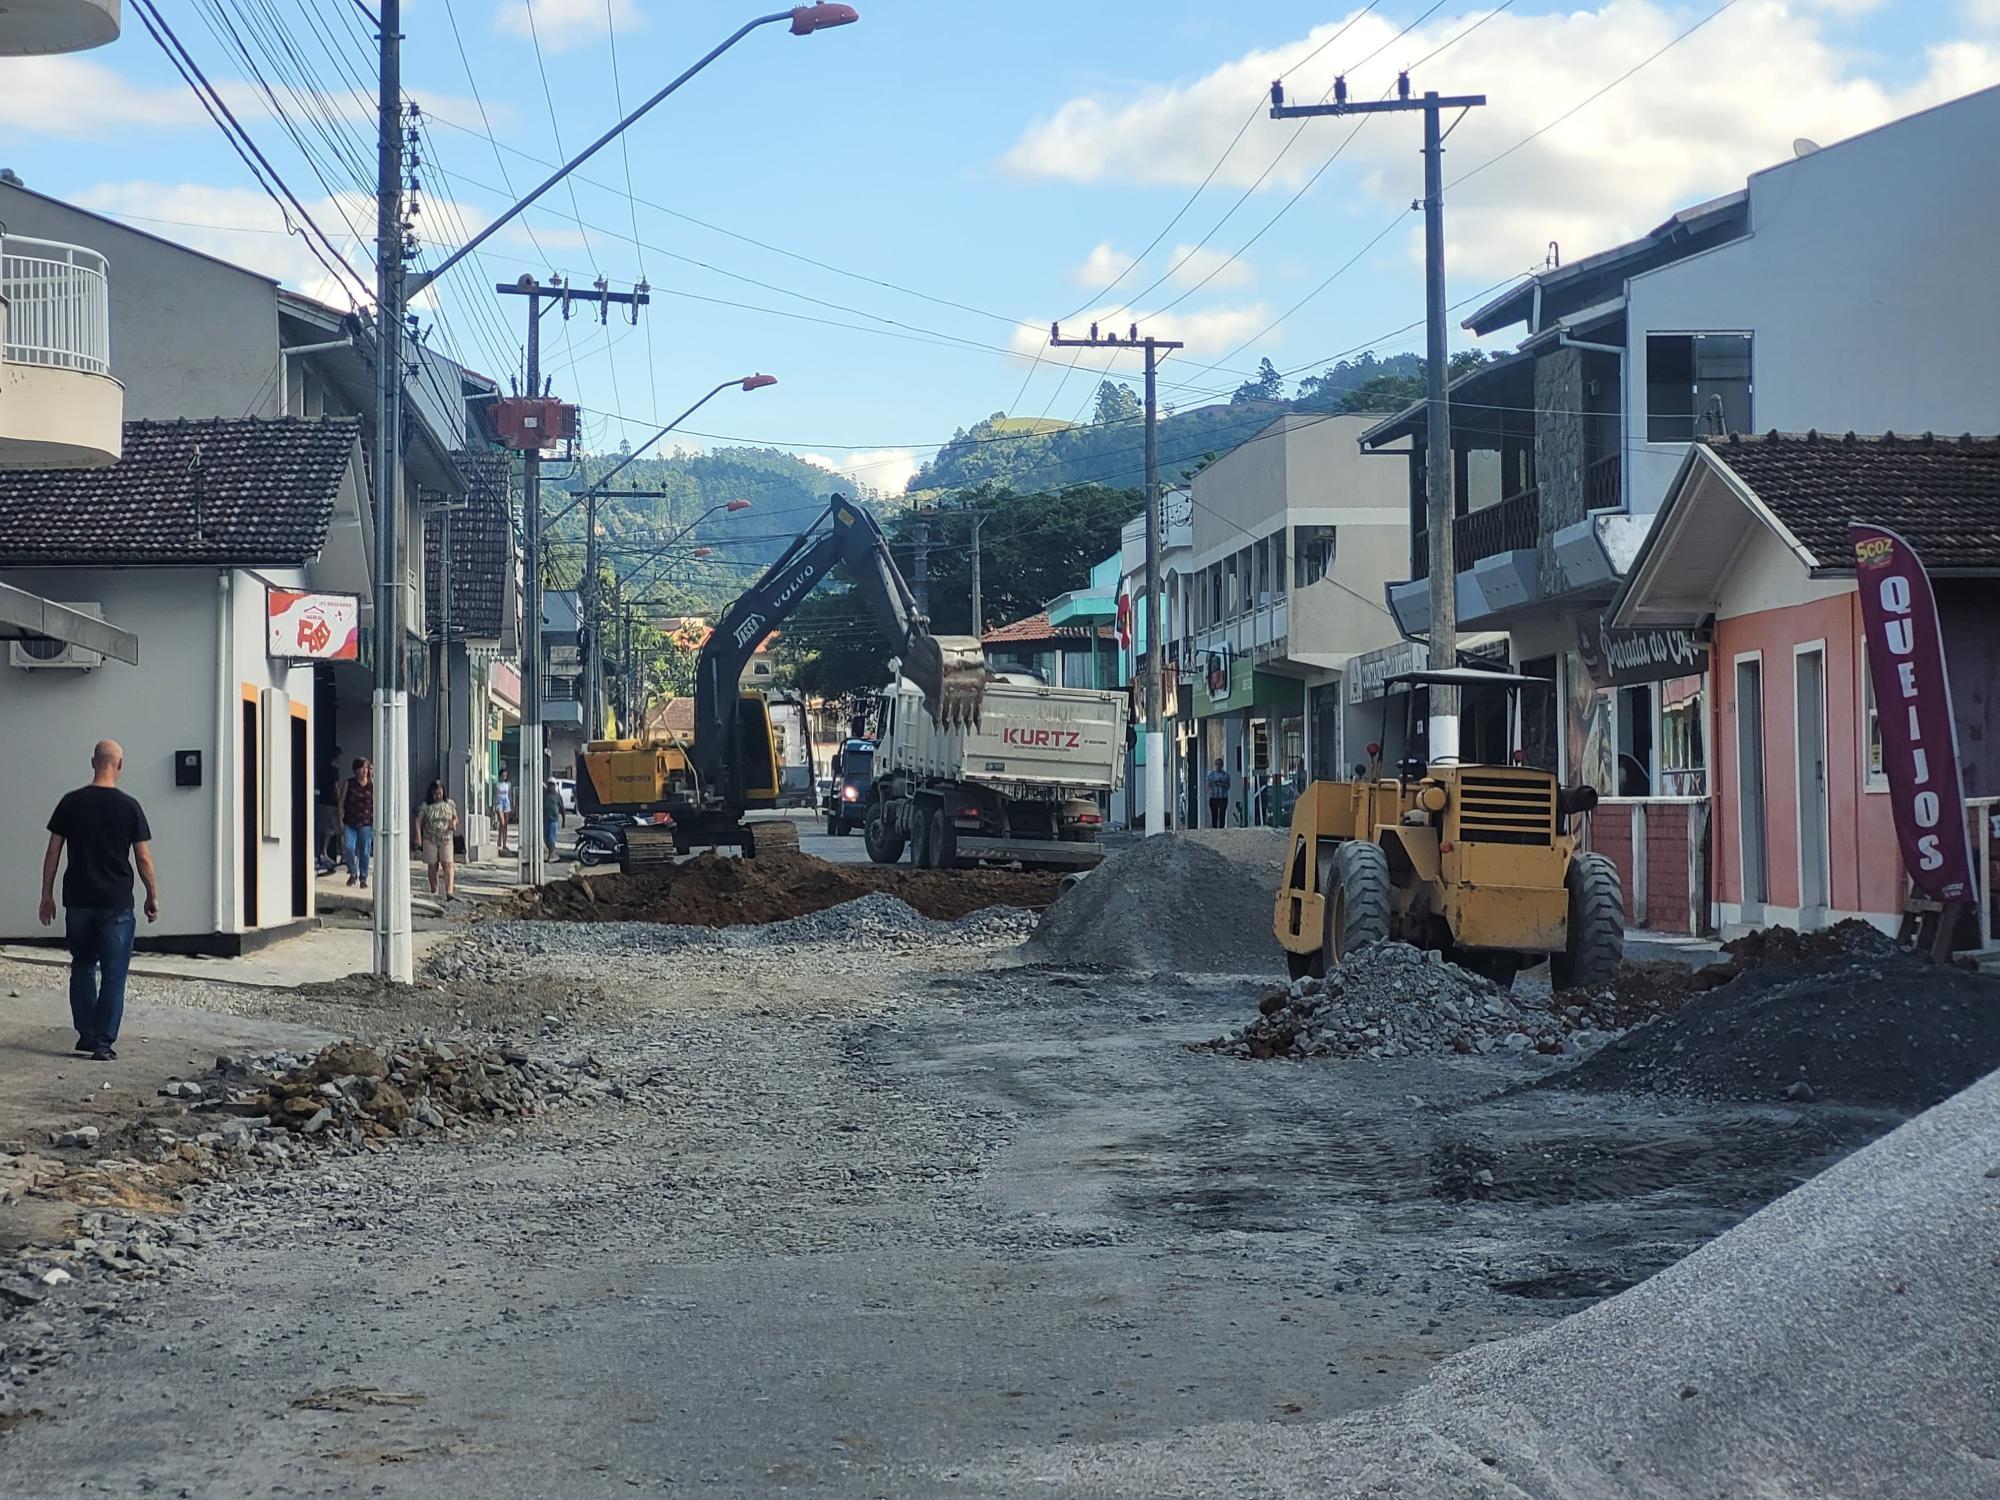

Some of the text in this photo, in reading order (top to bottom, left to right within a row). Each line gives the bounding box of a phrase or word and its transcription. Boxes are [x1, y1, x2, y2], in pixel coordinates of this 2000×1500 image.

[773, 565, 814, 607] VOLVO
[1600, 629, 1651, 678] Parada
[1003, 727, 1080, 748] KURTZ
[1879, 576, 1944, 871] QUEIJOS
